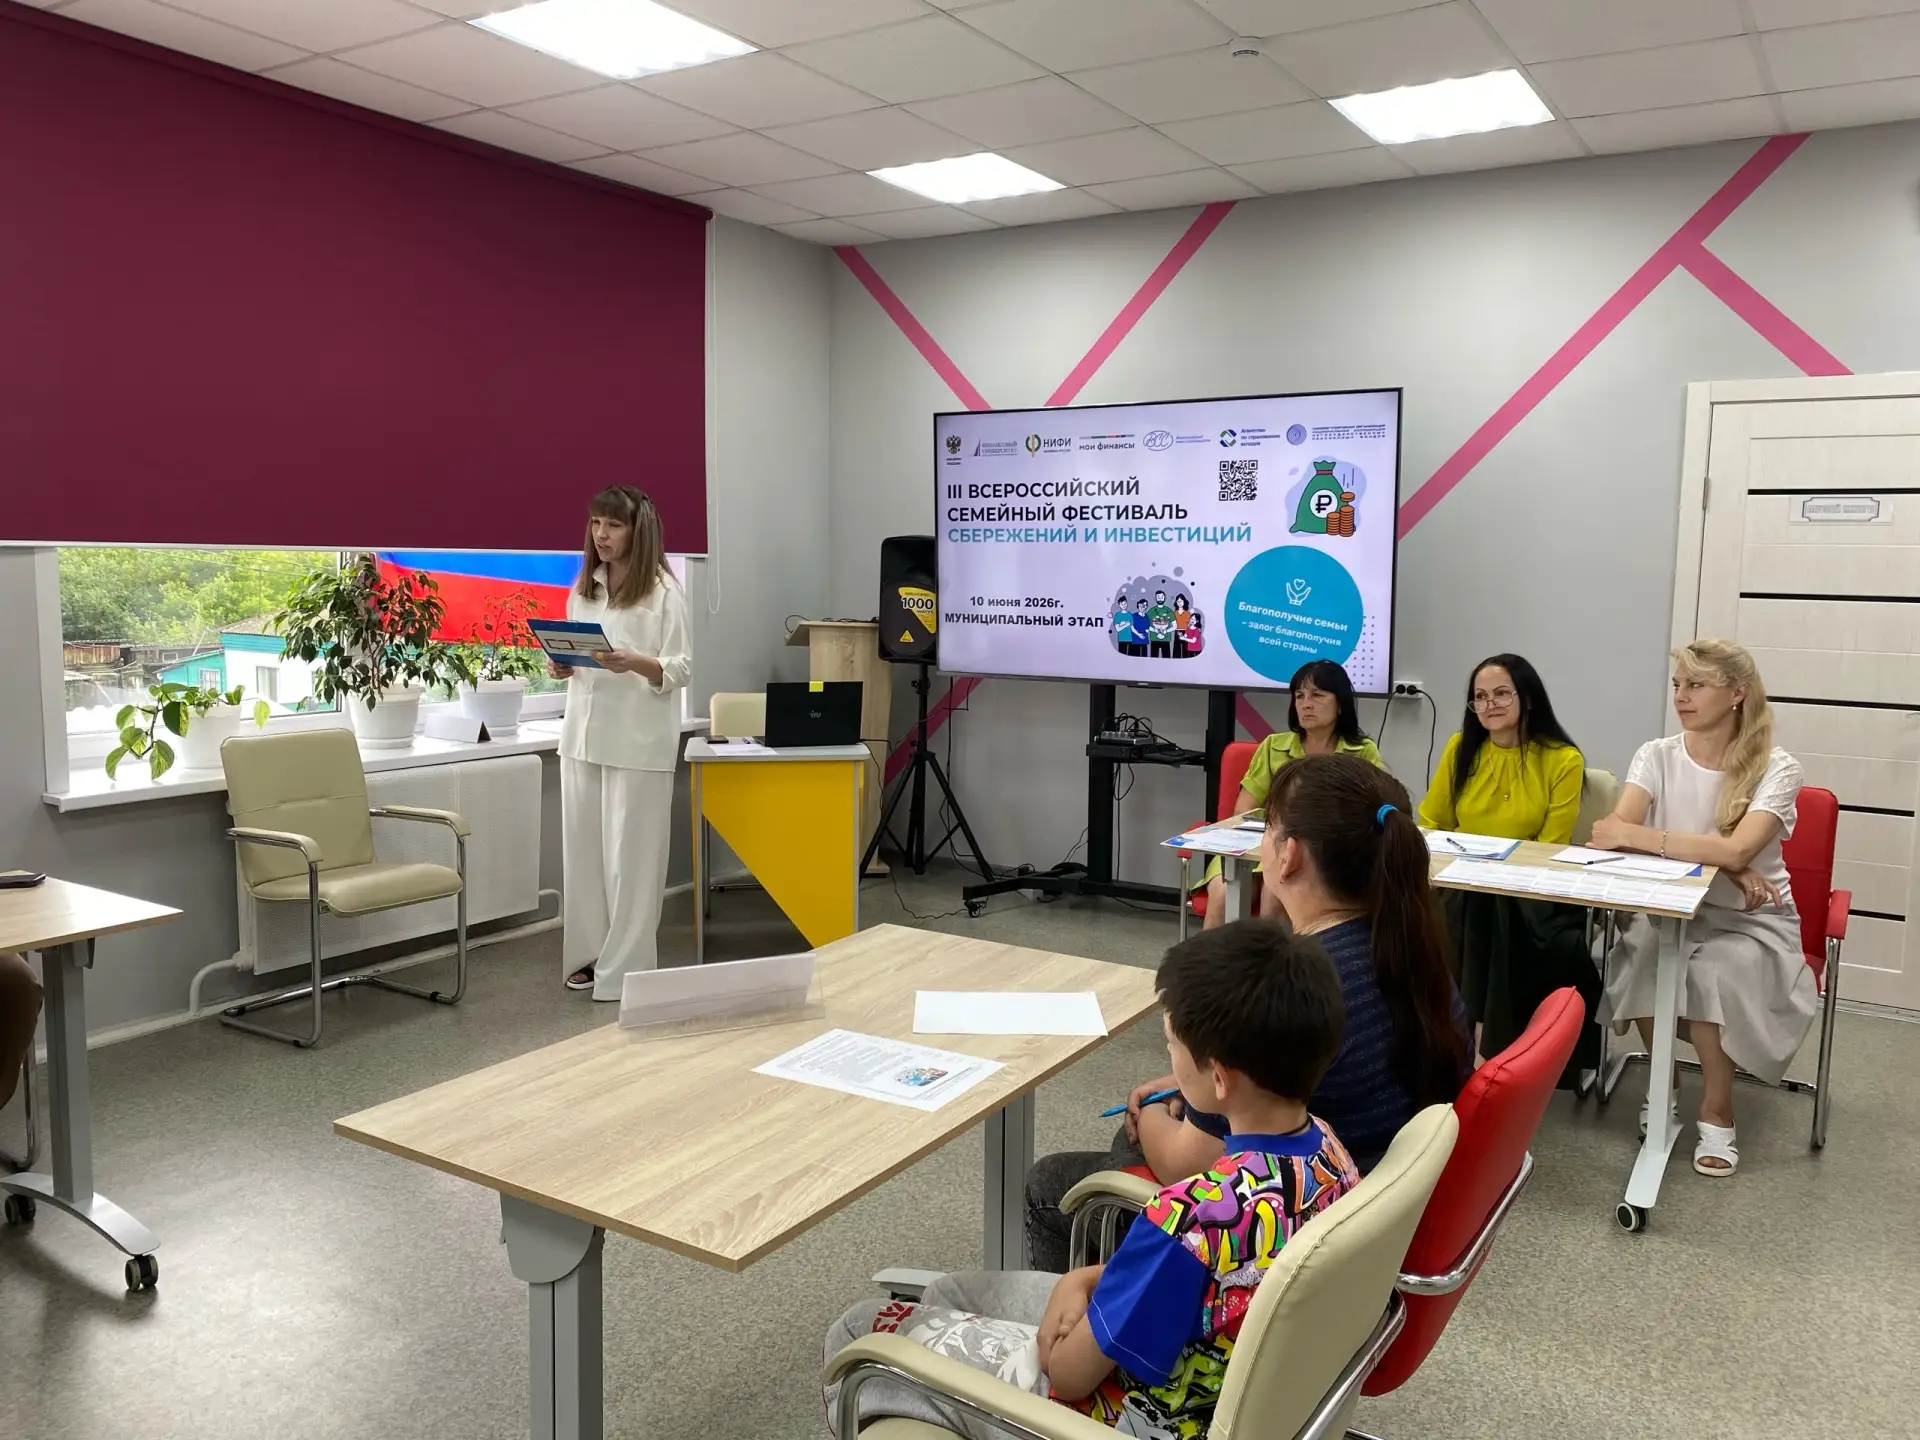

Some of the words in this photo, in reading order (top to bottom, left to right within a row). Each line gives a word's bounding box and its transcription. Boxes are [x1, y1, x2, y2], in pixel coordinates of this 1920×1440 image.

[1043, 437, 1071, 447] НИФИ
[1097, 441, 1135, 452] финансы
[968, 476, 1140, 499] ВСЕРОССИЙСКИЙ
[947, 502, 1056, 522] СЕМЕЙНЫЙ
[1062, 503, 1188, 521] ФЕСТИВАЛЬ
[947, 524, 1077, 543] СБЕРЕЖЕНИЙ
[1084, 527, 1098, 543] И
[1104, 522, 1252, 545] ИНВЕСТИЦИЙ
[901, 597, 934, 610] 1000
[970, 596, 984, 607] 10
[987, 598, 1021, 607] июня
[1024, 597, 1065, 608] 2026г.
[944, 613, 1063, 627] МУНИЦИПАЛЬНЫЙ
[1067, 616, 1104, 627] ЭТАП
[1238, 601, 1312, 625] Благополучие
[1314, 618, 1348, 632] семьи
[1248, 621, 1275, 633] залог
[1275, 625, 1341, 646] благополучия
[1258, 636, 1281, 647] всей
[1282, 641, 1318, 654] страны
